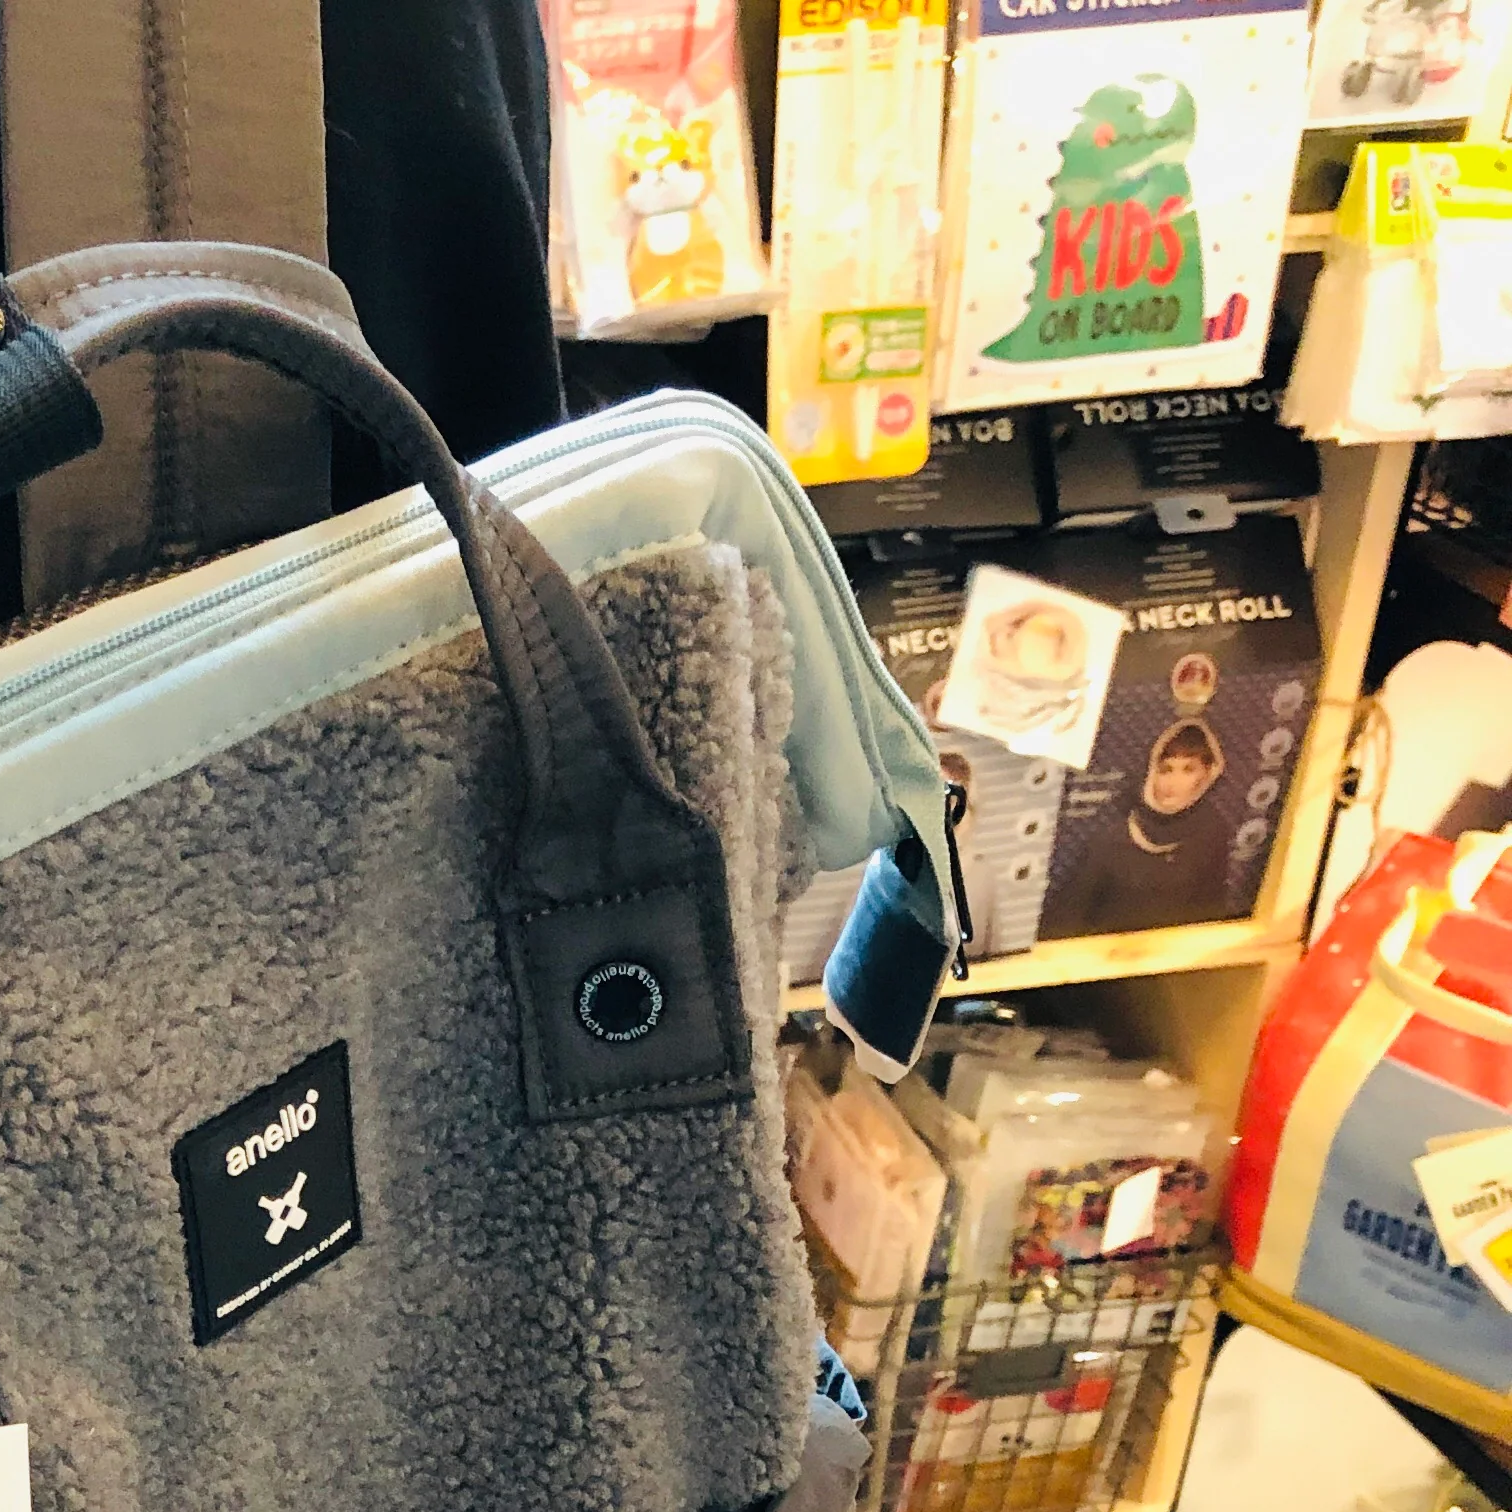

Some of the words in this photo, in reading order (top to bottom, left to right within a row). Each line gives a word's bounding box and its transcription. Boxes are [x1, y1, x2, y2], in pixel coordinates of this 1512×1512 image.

[1047, 195, 1183, 300] KIDS
[1139, 602, 1215, 632] NECK
[1219, 595, 1293, 624] ROLL
